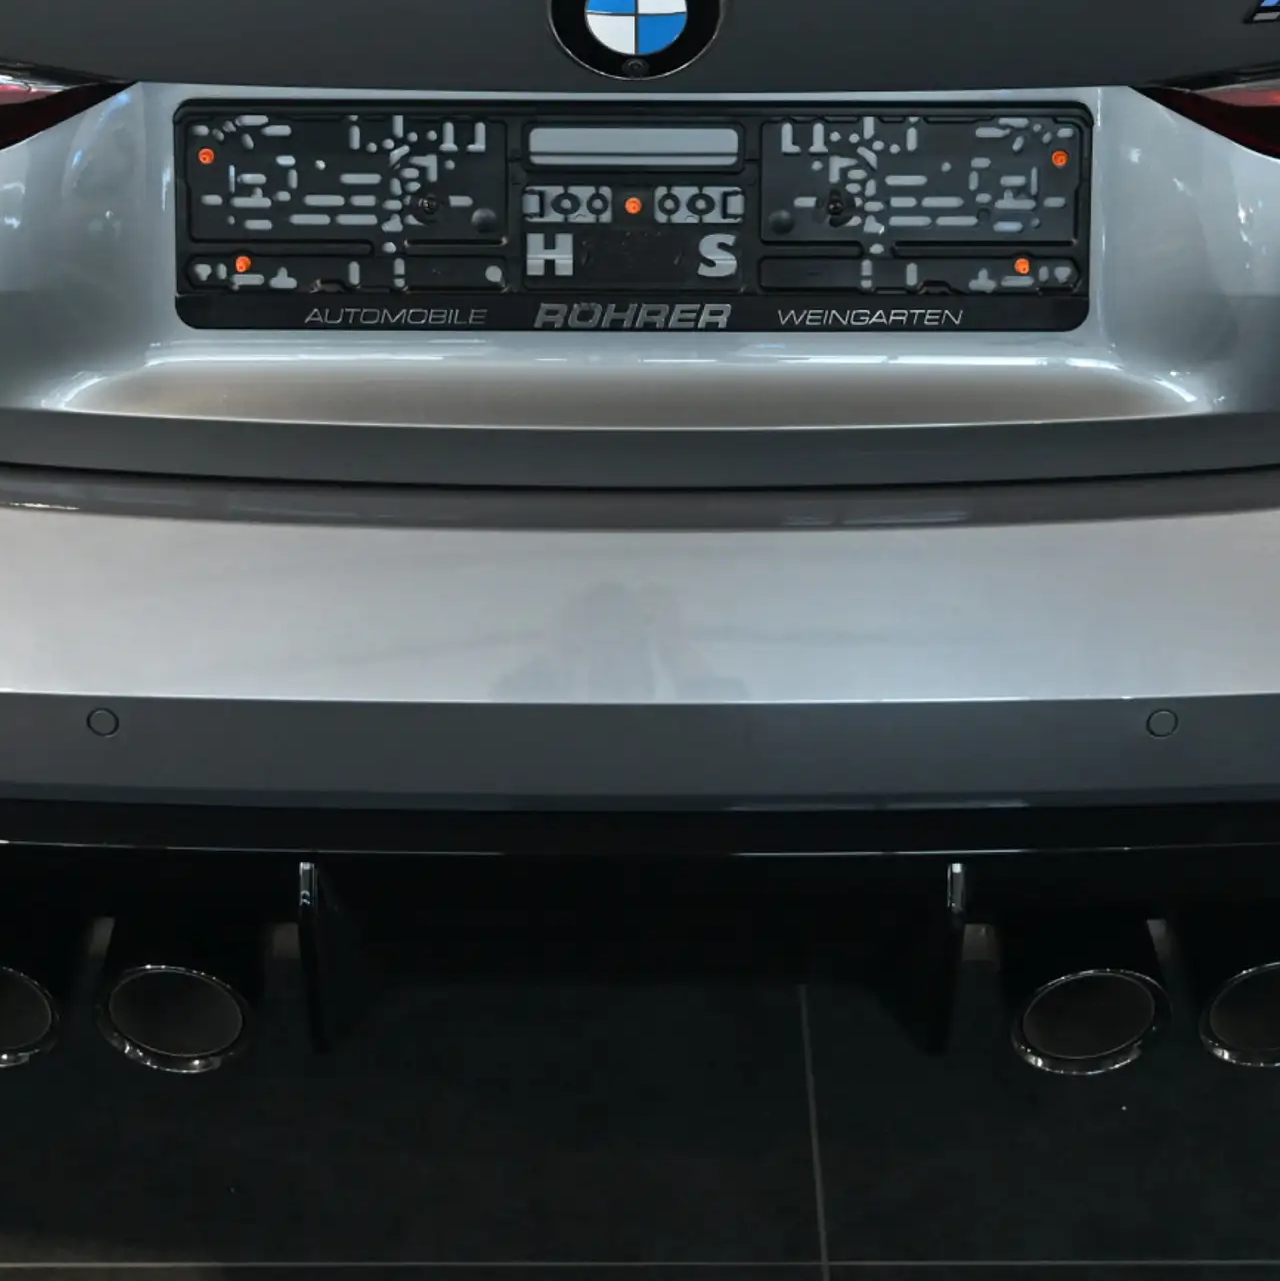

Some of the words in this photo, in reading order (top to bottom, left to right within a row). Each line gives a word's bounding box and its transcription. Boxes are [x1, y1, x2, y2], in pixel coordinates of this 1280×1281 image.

[304, 308, 488, 325] AUTOMOBILE
[533, 302, 732, 329] RÖHRER
[777, 308, 964, 326] WEINGARTEN
